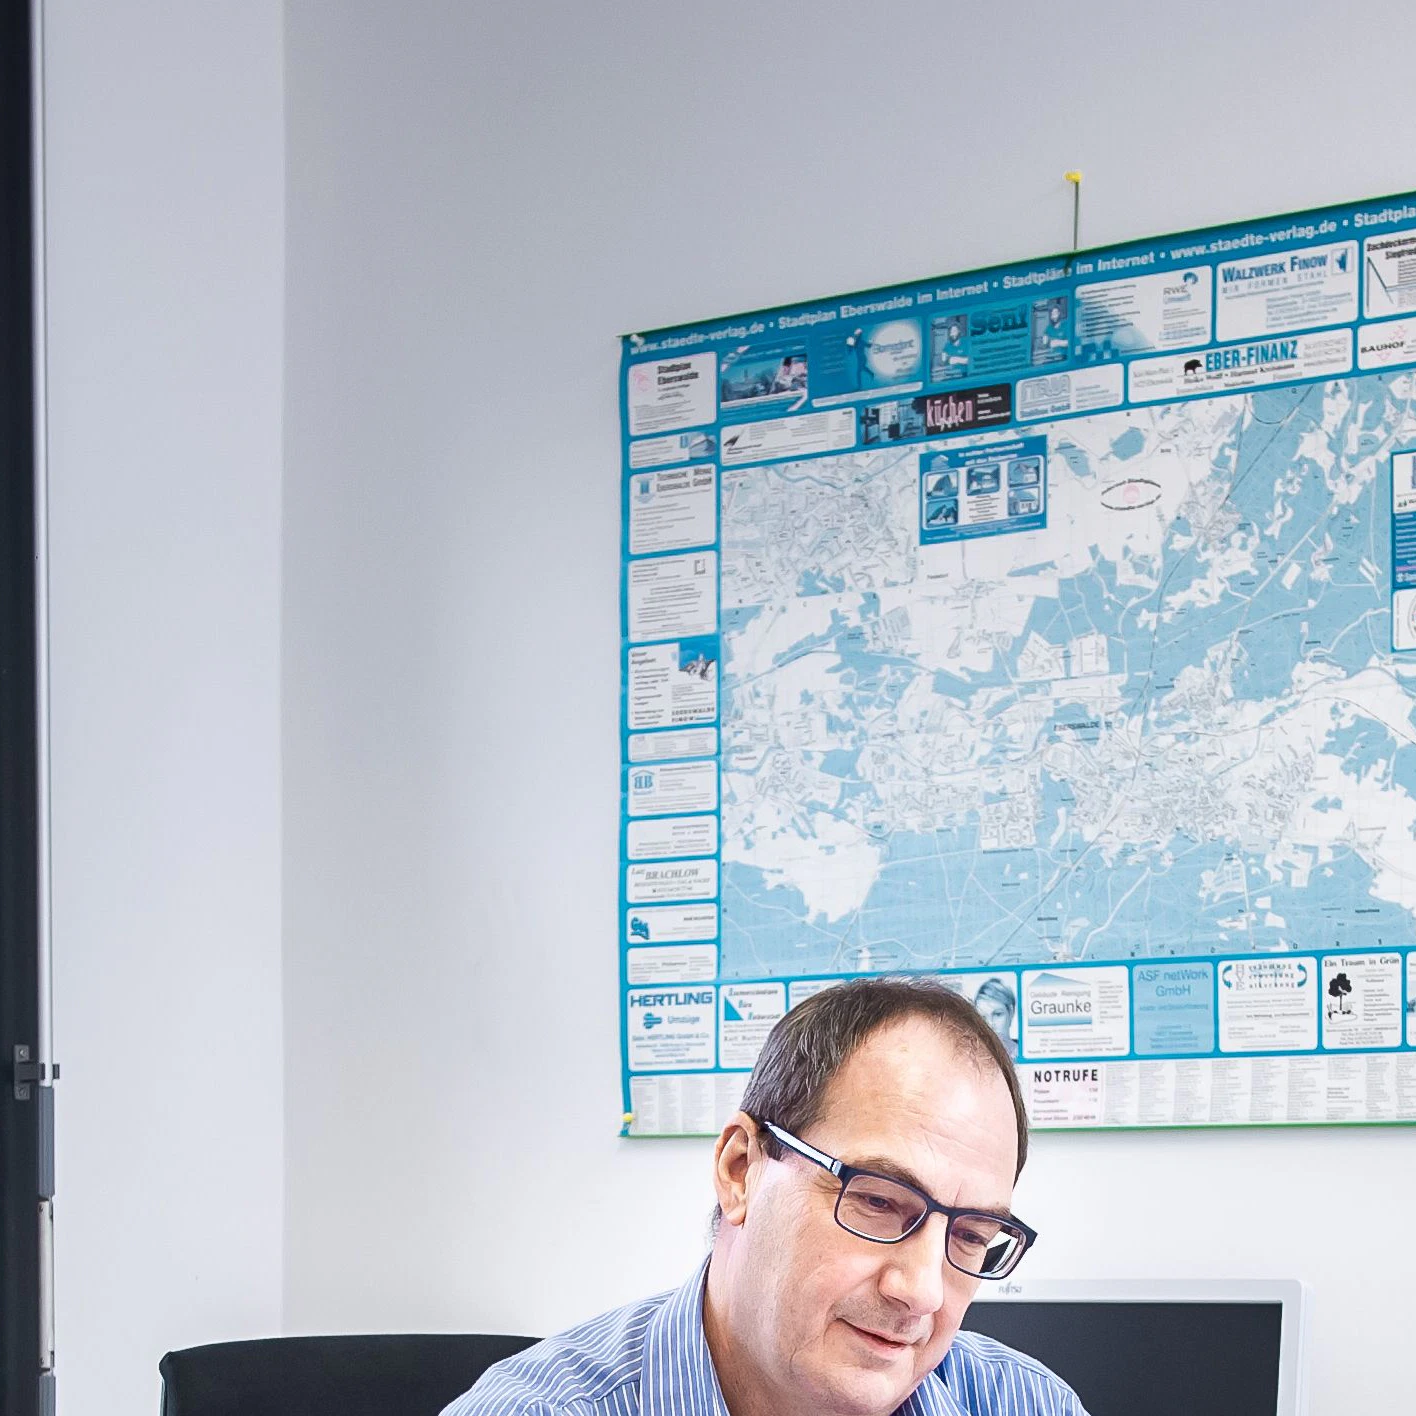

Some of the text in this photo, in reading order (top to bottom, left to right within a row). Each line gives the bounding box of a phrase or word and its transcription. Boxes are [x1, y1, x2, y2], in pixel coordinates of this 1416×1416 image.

[778, 308, 837, 330] Stadtplan
[839, 296, 914, 319] Eberswalde
[917, 292, 933, 304] im
[936, 281, 989, 301] Internet
[1075, 261, 1093, 275] im
[1098, 250, 1155, 271] Internet
[1170, 220, 1337, 260] www.staedte-verlag.de
[1222, 254, 1328, 283] WALZWERK FINOW
[1205, 339, 1298, 373] EBER-FINANZ
[1137, 968, 1209, 982] ASF netWork
[1155, 984, 1192, 998] GmbH
[630, 991, 713, 1008] HERTLING
[1030, 999, 1092, 1015] Graunke
[1034, 1069, 1099, 1083] NOTRUFE
